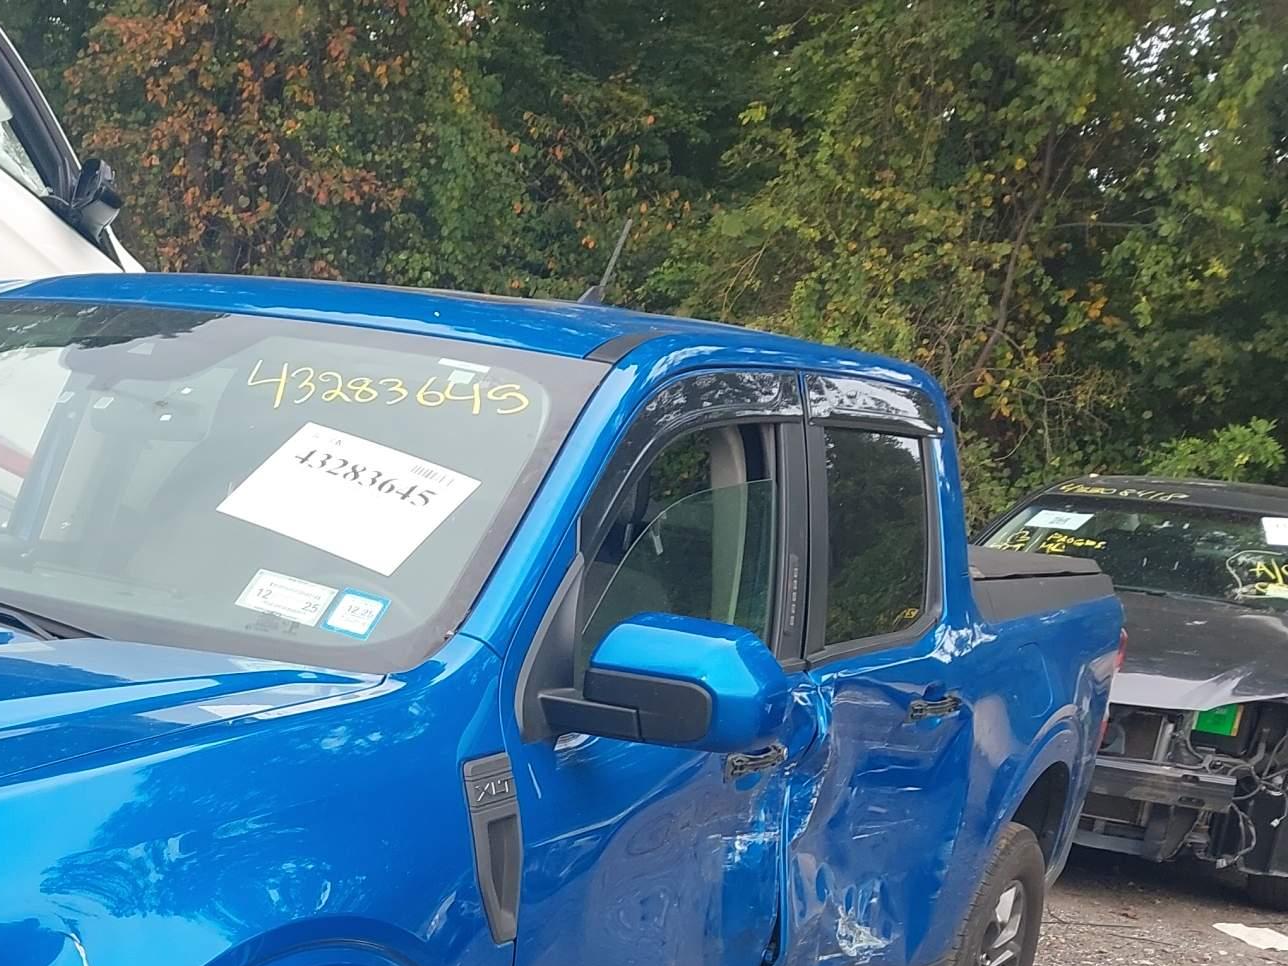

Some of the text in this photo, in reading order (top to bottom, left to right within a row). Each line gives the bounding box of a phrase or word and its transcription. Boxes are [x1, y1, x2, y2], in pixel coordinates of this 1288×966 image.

[248, 359, 529, 414] 43283645
[294, 449, 438, 507] 43283645
[256, 587, 273, 600] 12
[301, 601, 320, 613] 25
[474, 779, 509, 802] XLT
